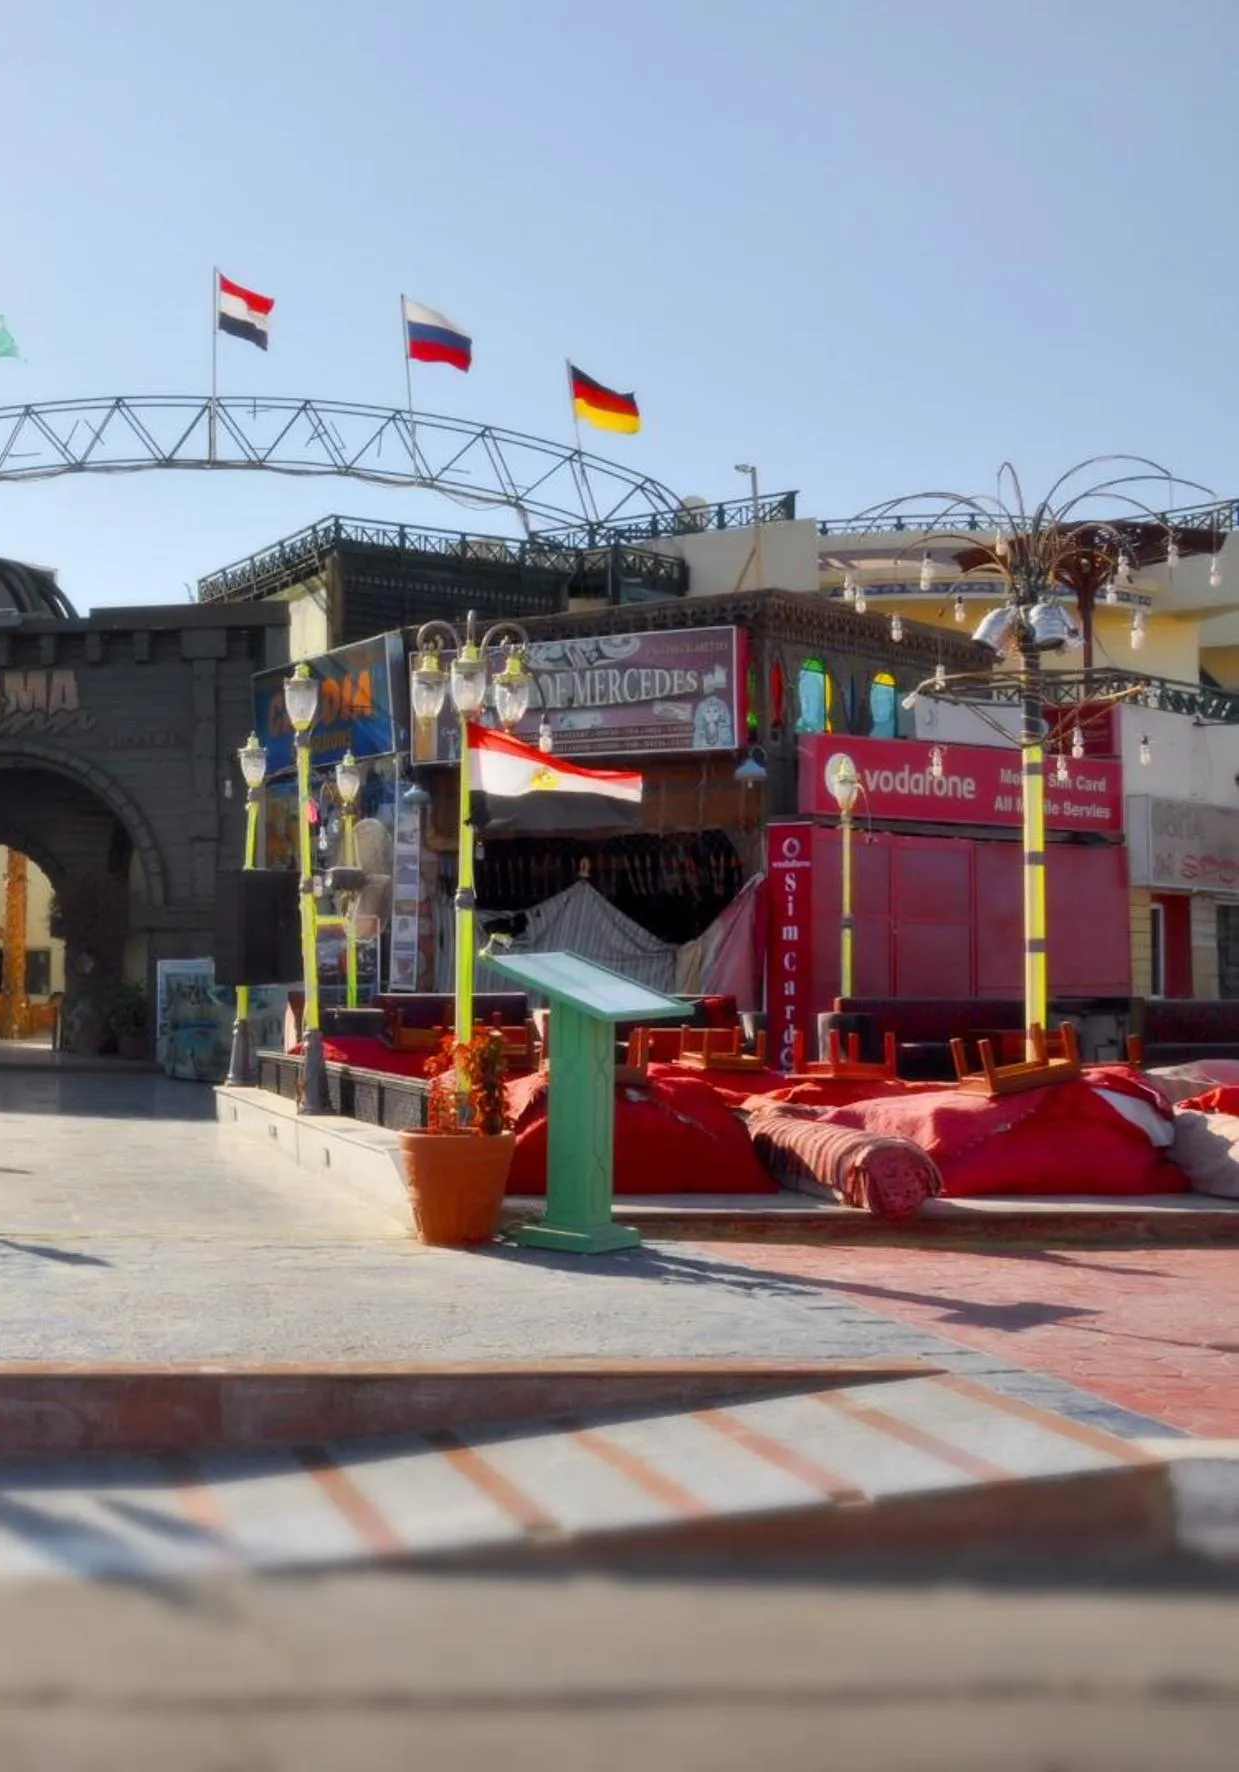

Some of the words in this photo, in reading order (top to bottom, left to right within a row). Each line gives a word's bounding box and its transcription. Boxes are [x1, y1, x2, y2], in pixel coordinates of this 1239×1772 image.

[572, 668, 698, 706] MERCEDES
[864, 764, 976, 799] vodafone
[1076, 776, 1106, 793] Card
